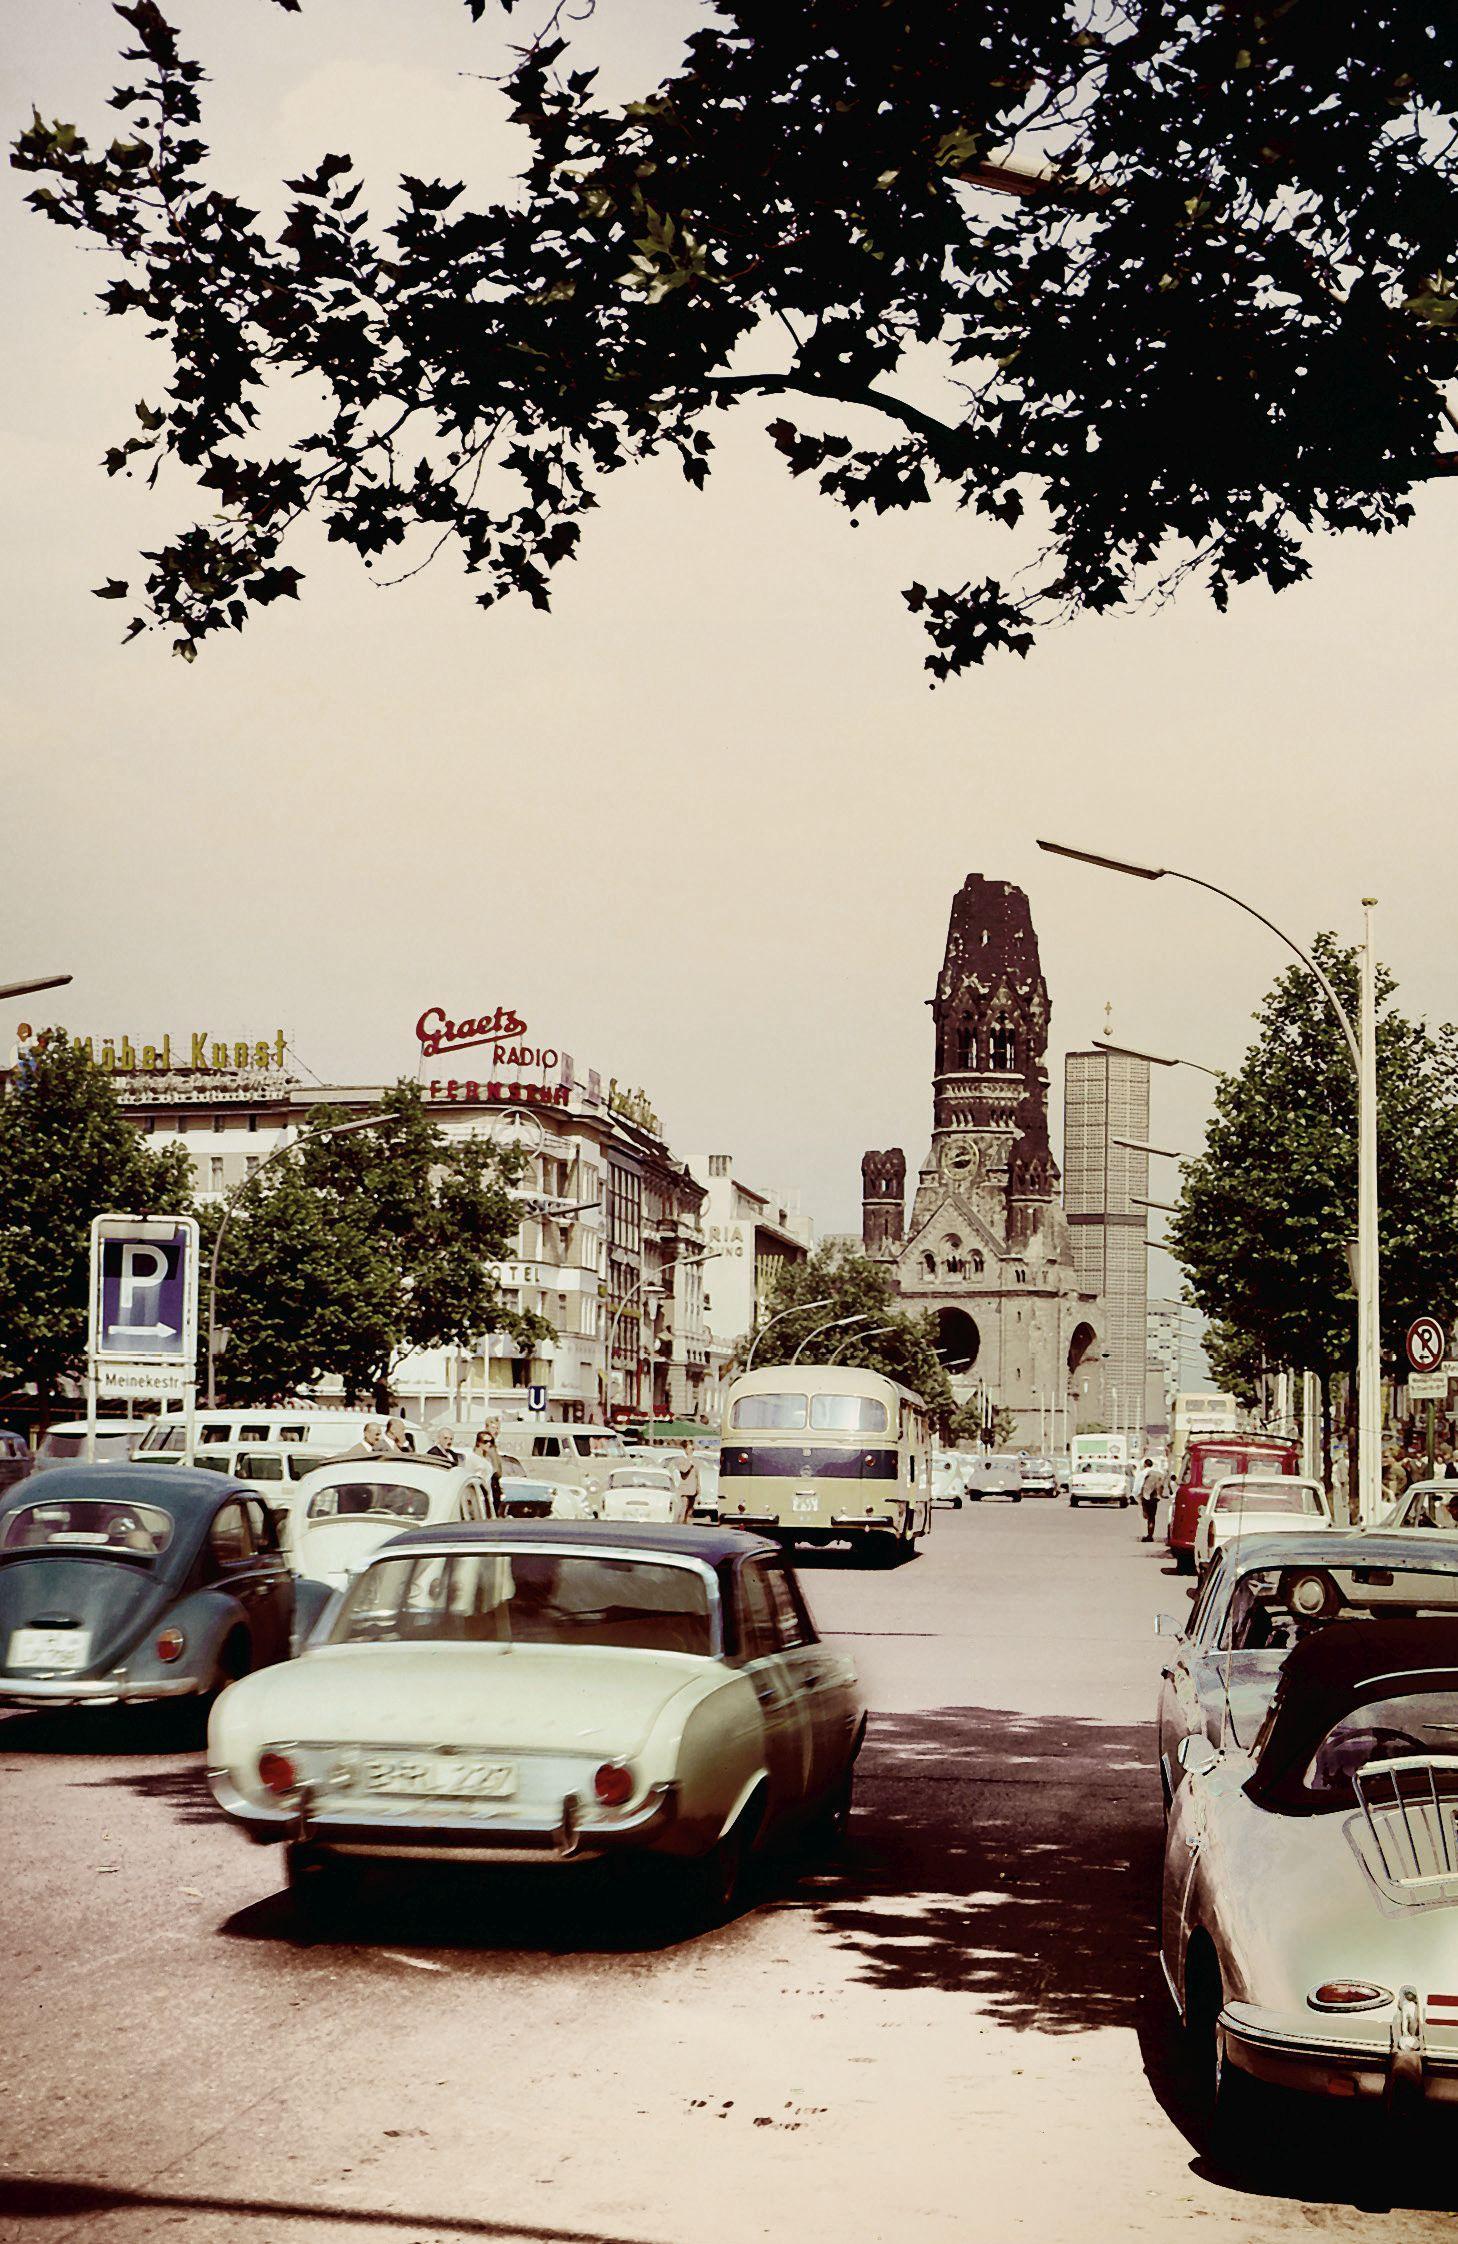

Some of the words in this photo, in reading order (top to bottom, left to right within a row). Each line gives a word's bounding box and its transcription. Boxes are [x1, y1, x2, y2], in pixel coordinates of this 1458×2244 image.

[73, 1033, 171, 1072] Möbel
[191, 1029, 288, 1070] Kunst
[493, 1045, 558, 1068] RADIO
[120, 1243, 169, 1309] P
[490, 1265, 540, 1282] OTEL
[530, 1388, 545, 1409] U
